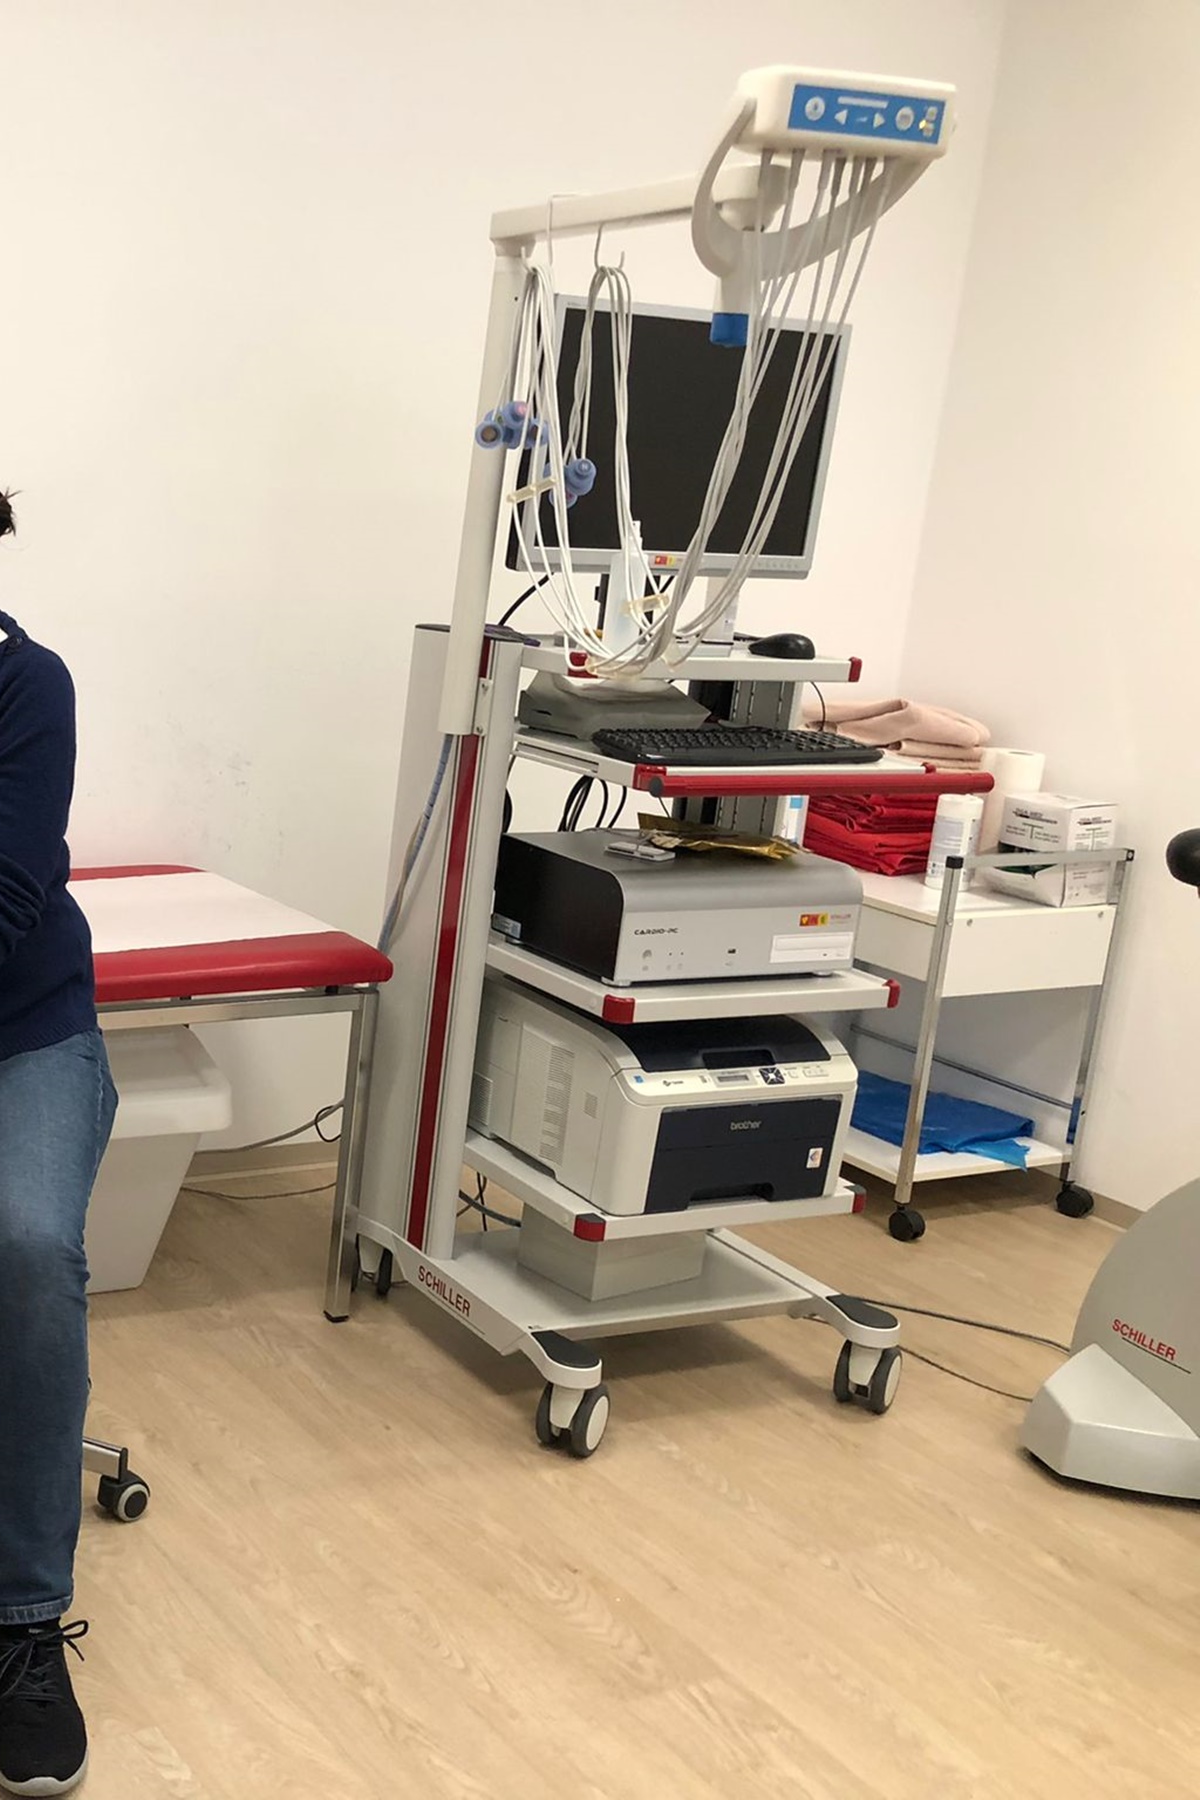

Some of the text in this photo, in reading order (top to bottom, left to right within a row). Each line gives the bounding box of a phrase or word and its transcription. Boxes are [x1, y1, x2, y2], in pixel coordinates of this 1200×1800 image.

[730, 1120, 762, 1131] brother
[418, 1265, 471, 1317] SCHILLER
[1112, 1319, 1176, 1360] SCHILLER
